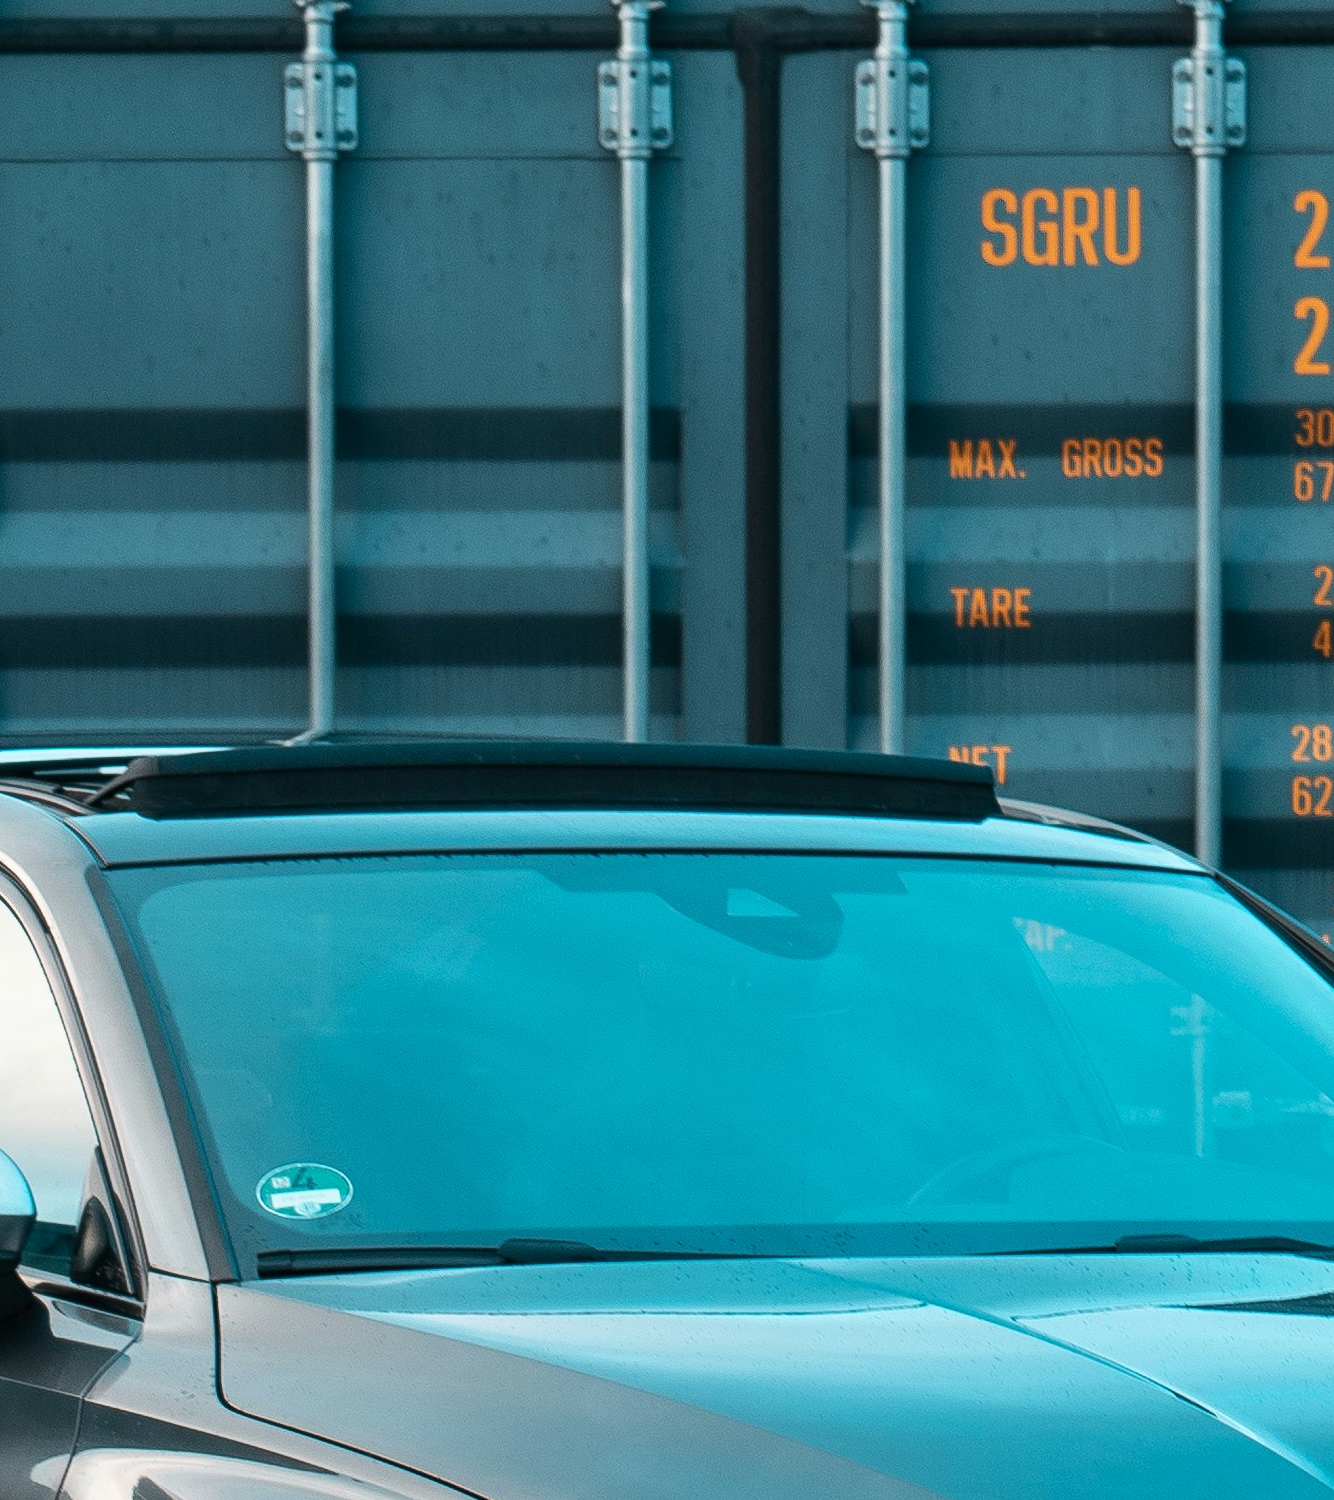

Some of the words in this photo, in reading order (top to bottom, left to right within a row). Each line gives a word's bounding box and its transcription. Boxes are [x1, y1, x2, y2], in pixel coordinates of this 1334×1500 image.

[982, 187, 1141, 266] SGRU
[950, 440, 1025, 477] MAX.
[1062, 437, 1163, 477] GROSS
[952, 588, 1030, 627] TARE
